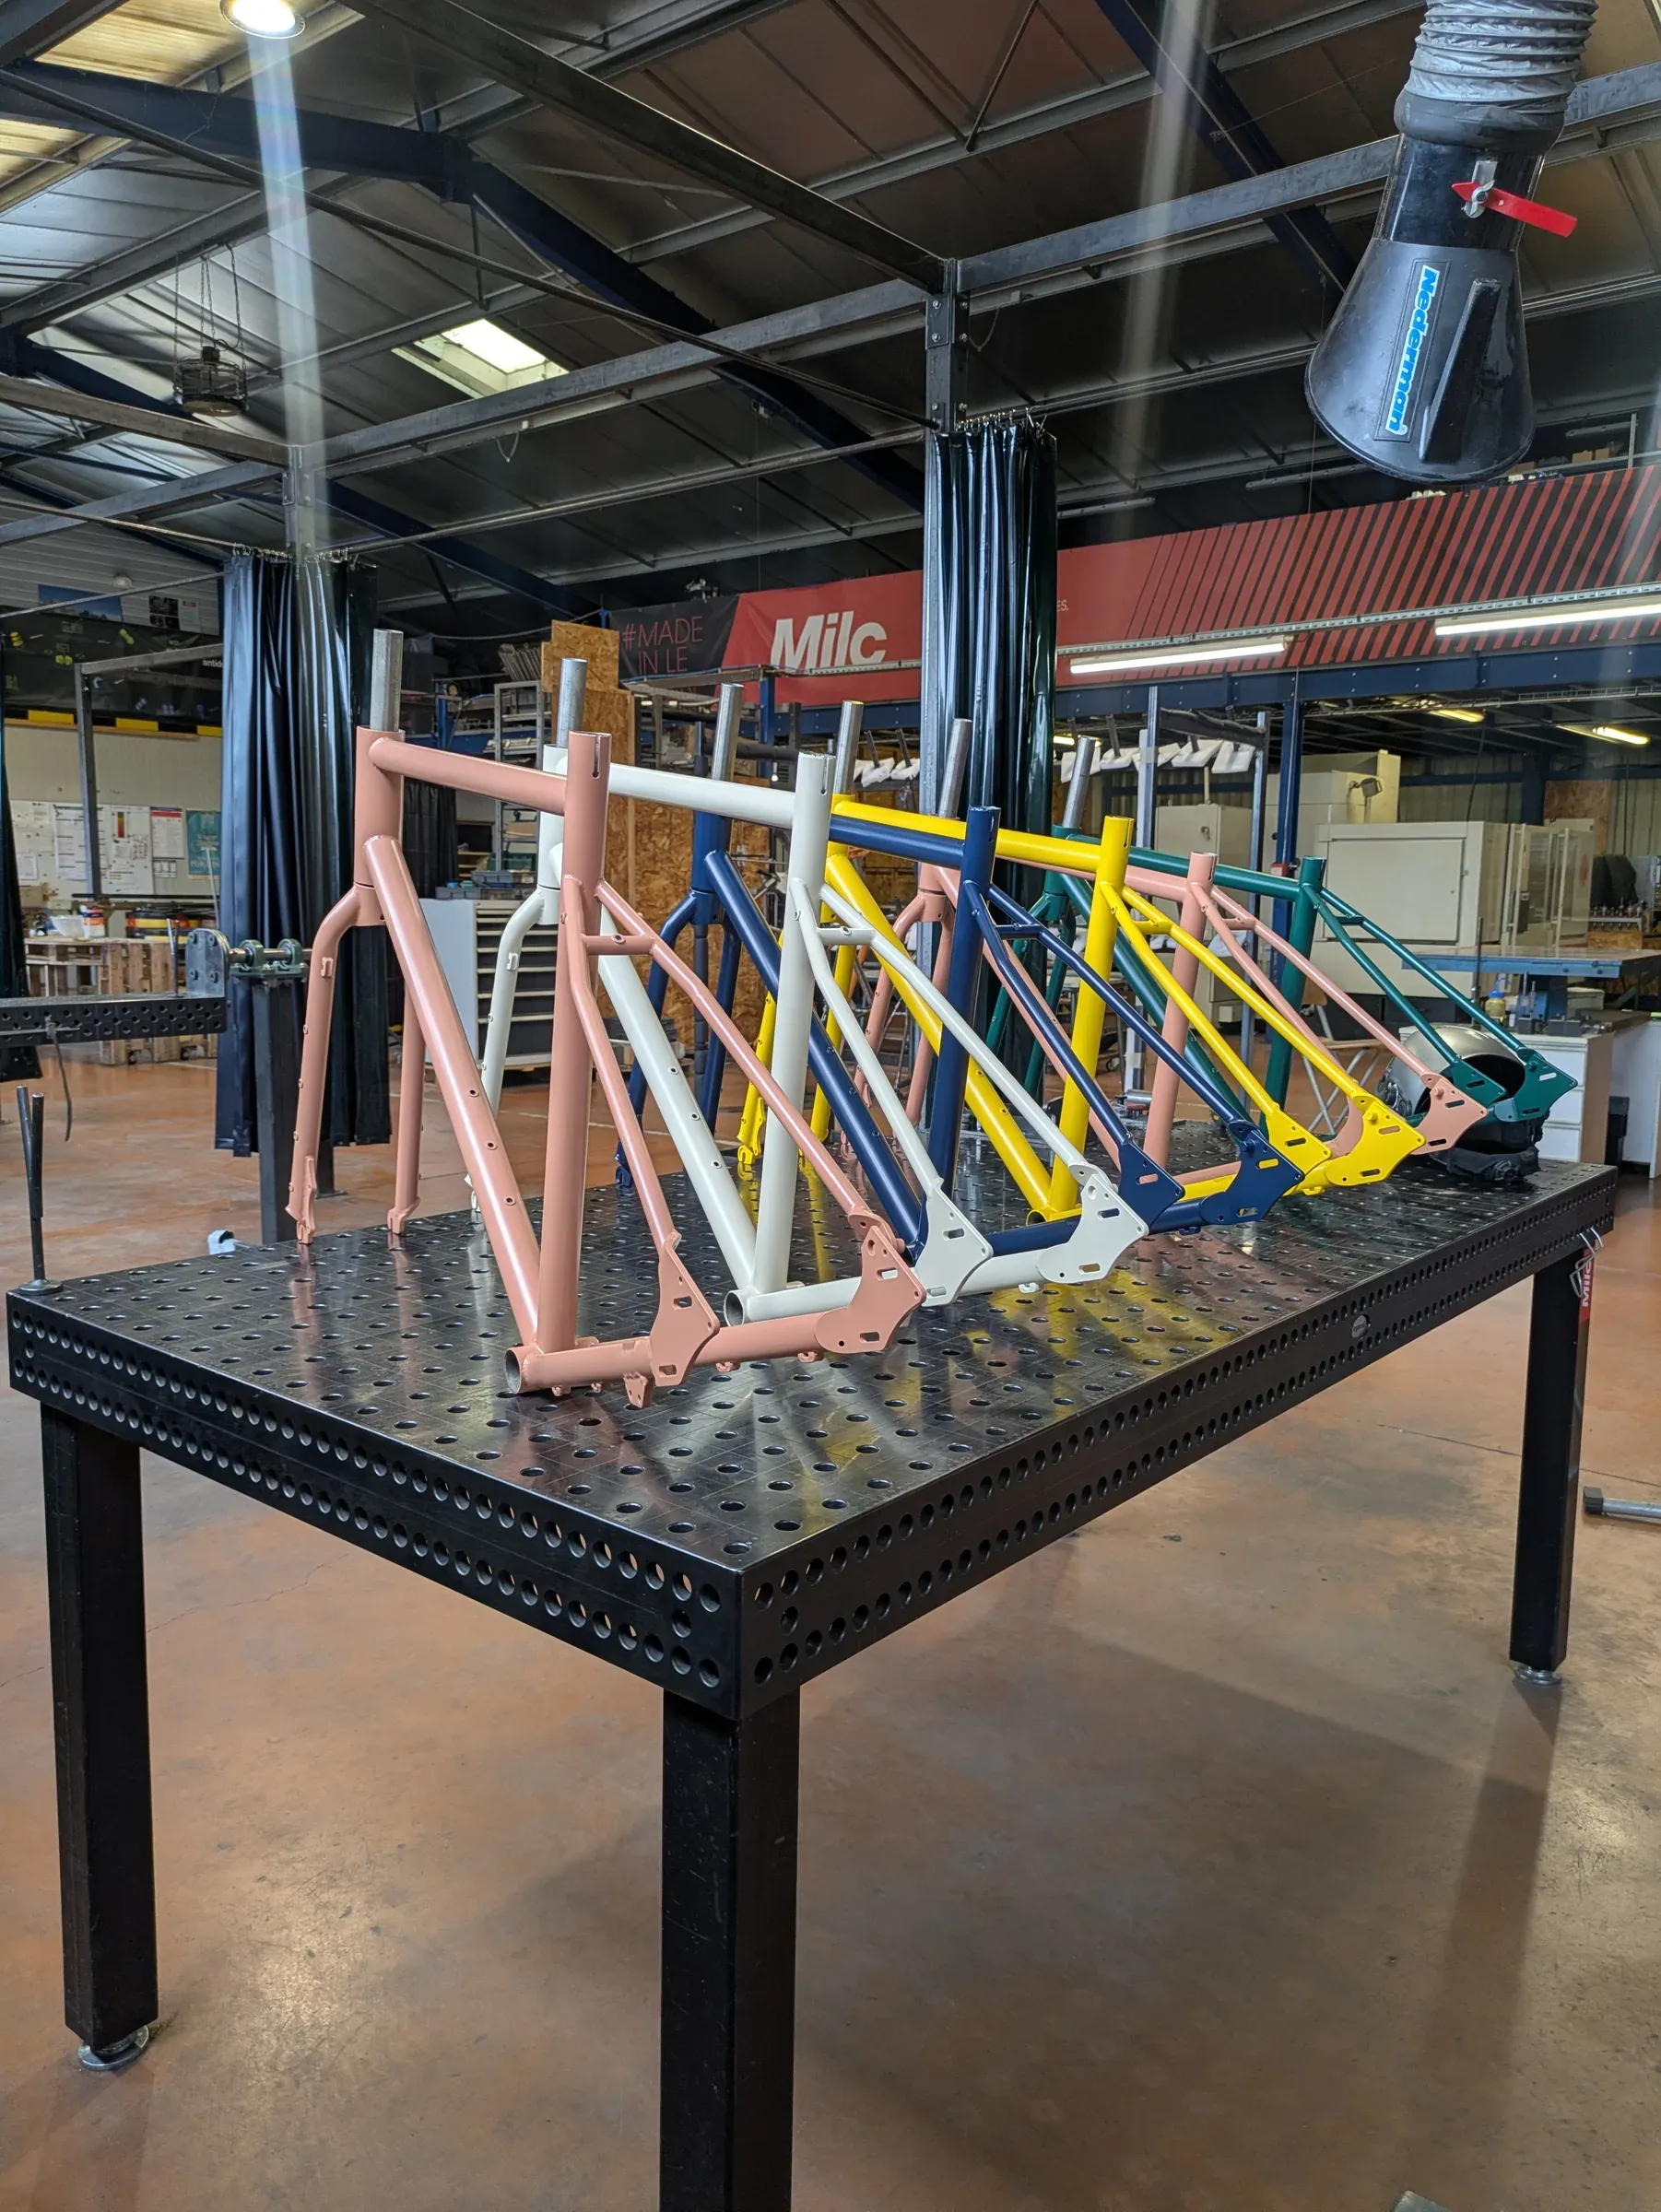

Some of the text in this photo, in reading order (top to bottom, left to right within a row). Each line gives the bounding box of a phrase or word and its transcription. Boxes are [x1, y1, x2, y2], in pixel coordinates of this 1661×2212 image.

[1386, 265, 1440, 433] Nederman
[622, 616, 703, 651] #MADE
[770, 610, 888, 671] Milc
[202, 659, 223, 668] antid
[639, 646, 689, 675] IN LE
